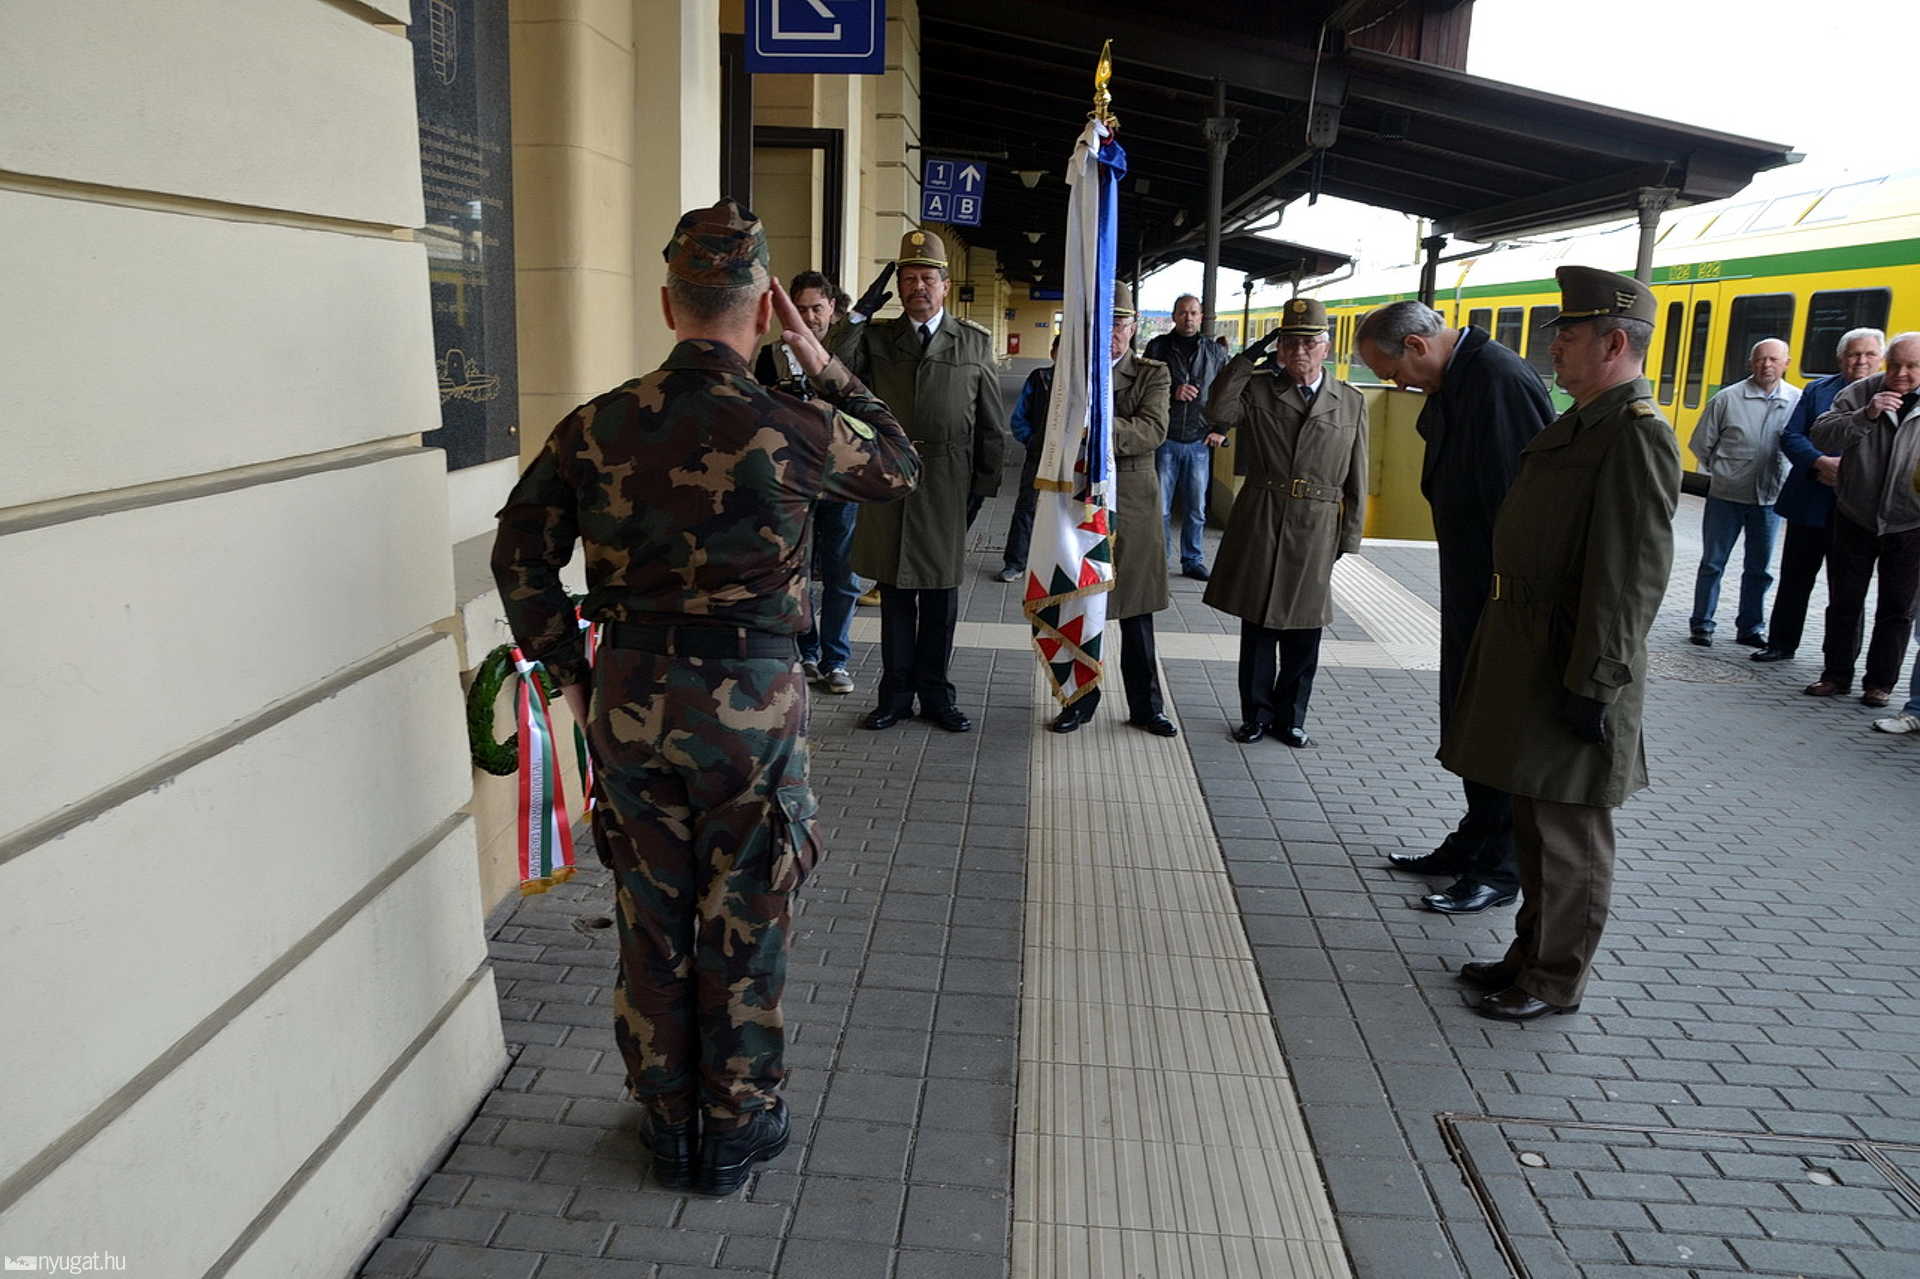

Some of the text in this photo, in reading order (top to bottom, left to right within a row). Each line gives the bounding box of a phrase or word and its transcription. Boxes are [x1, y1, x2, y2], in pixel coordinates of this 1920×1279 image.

[937, 164, 944, 180] 1
[929, 196, 942, 210] A
[961, 198, 974, 214] B
